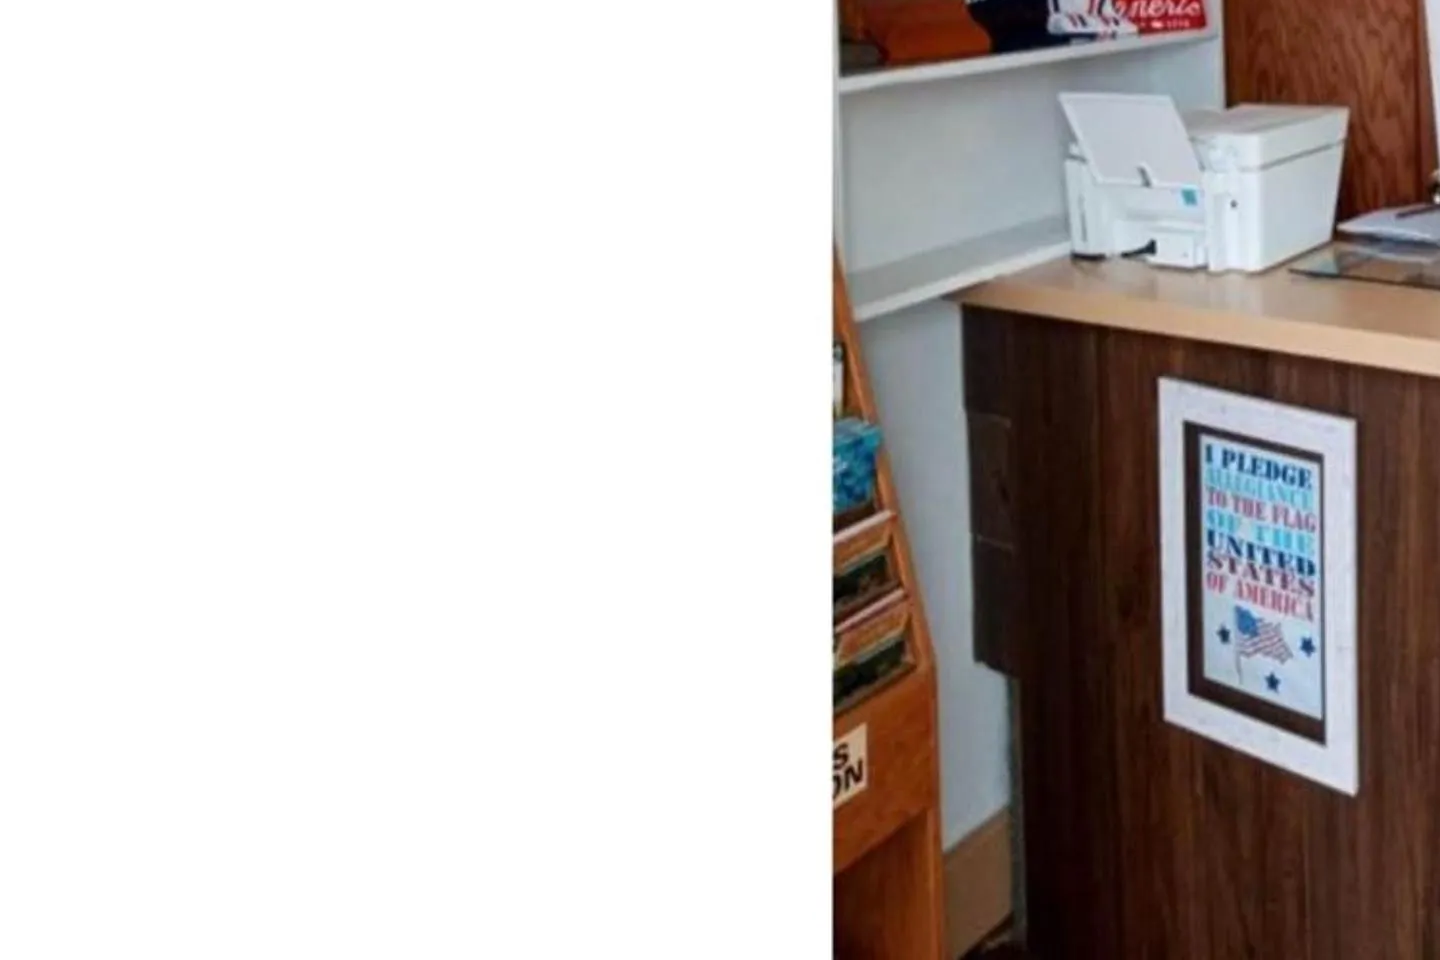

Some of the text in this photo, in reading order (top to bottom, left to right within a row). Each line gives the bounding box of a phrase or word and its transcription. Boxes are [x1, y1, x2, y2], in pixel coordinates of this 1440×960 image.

[1204, 443, 1313, 490] I PLEDGE
[1207, 487, 1317, 533] TO THE FLAG
[1206, 529, 1316, 578] UNITED
[1207, 550, 1315, 598] STATES
[1206, 571, 1314, 622] OF AMERICA
